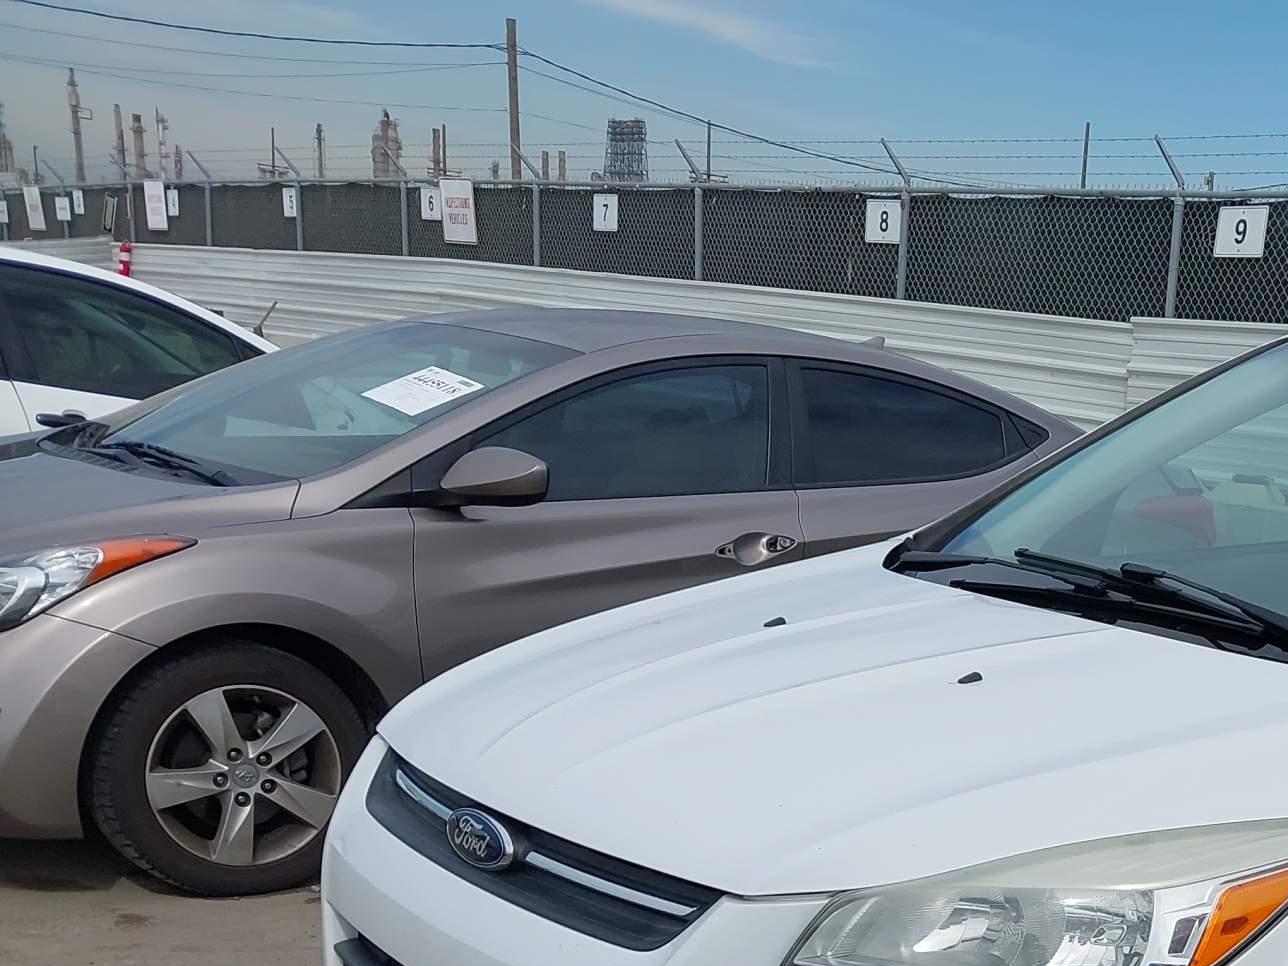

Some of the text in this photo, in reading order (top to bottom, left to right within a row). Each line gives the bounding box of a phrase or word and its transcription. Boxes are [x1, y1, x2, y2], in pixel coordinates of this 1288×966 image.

[289, 195, 294, 210] 5
[428, 195, 434, 212] 6
[602, 203, 609, 221] 7
[879, 210, 889, 233] 8
[1234, 218, 1248, 245] 9
[454, 815, 490, 857] Ford
